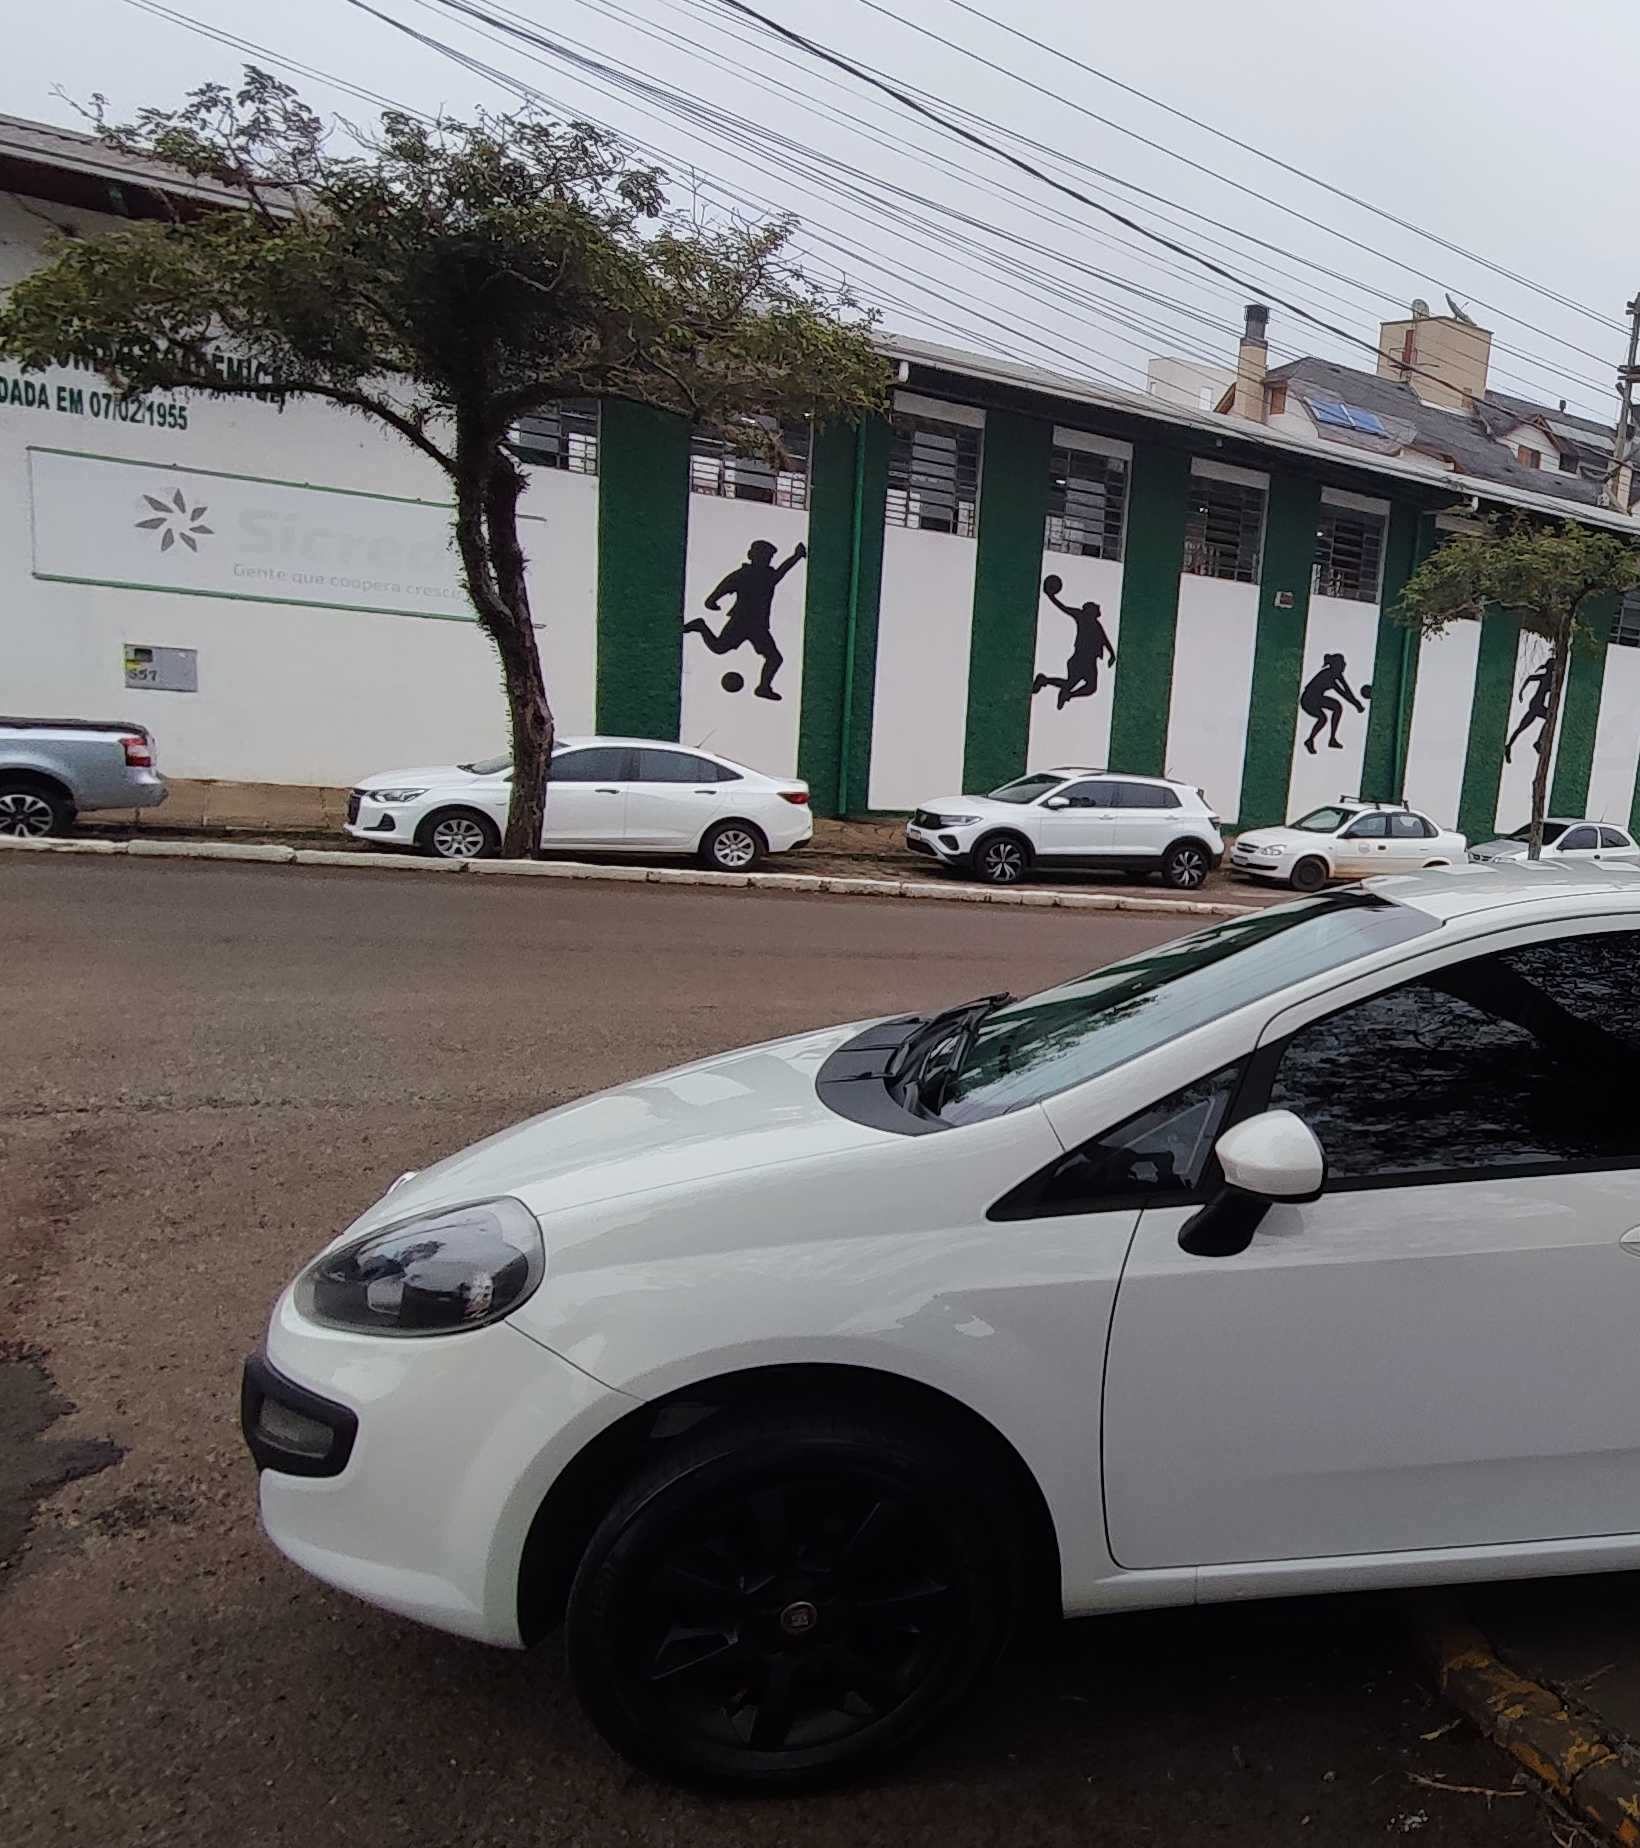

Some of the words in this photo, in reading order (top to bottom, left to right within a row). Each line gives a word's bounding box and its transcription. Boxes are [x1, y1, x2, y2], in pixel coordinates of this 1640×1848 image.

[57, 385, 84, 415] EM
[89, 391, 188, 430] 07/02/1955
[237, 506, 447, 570] Sicred
[232, 562, 287, 580] Gente
[291, 569, 325, 587] que
[329, 576, 401, 594] coopera
